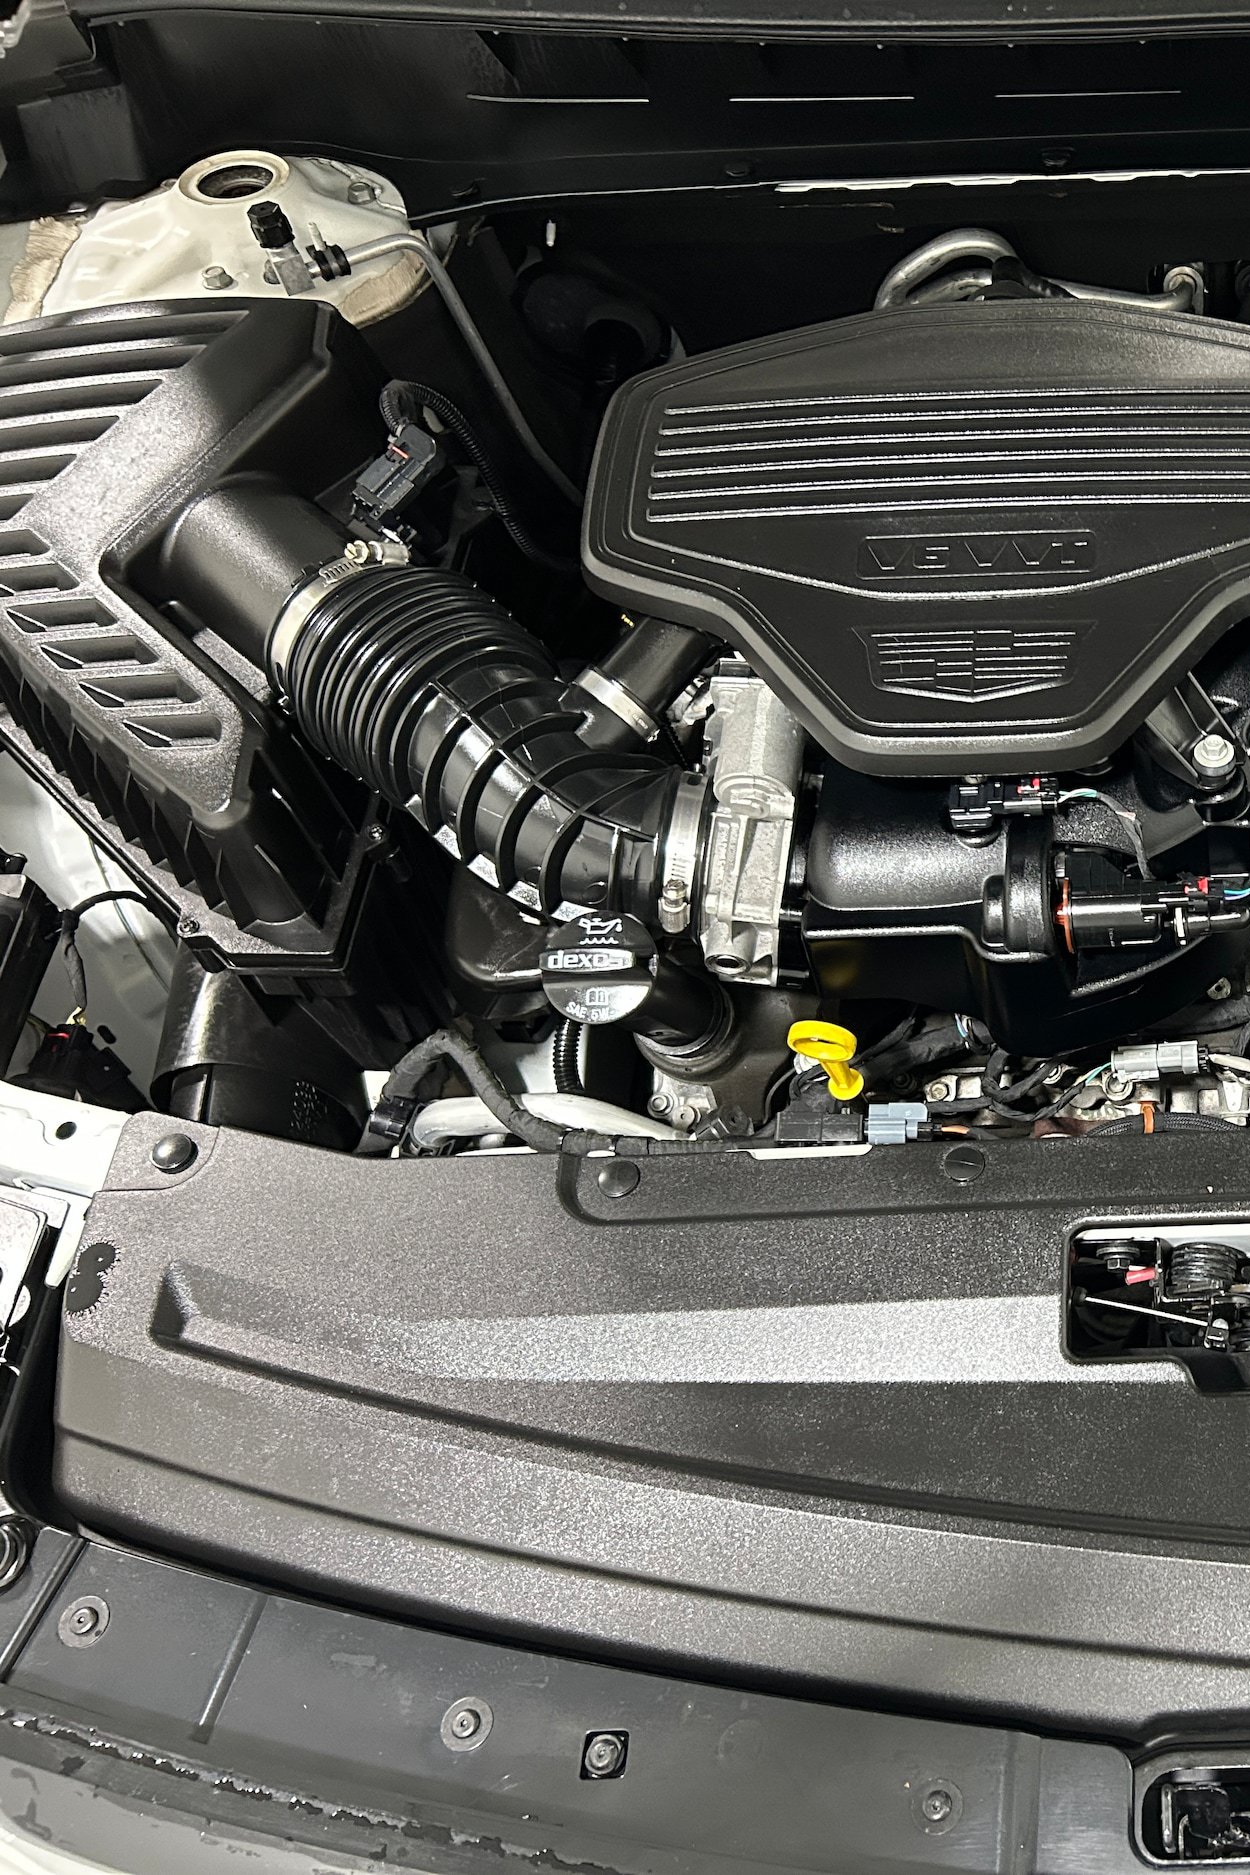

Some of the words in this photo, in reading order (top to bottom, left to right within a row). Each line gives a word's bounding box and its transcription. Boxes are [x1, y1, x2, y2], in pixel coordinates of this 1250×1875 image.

[867, 544, 950, 570] V6
[963, 539, 1088, 567] VVT
[547, 950, 624, 969] dexos
